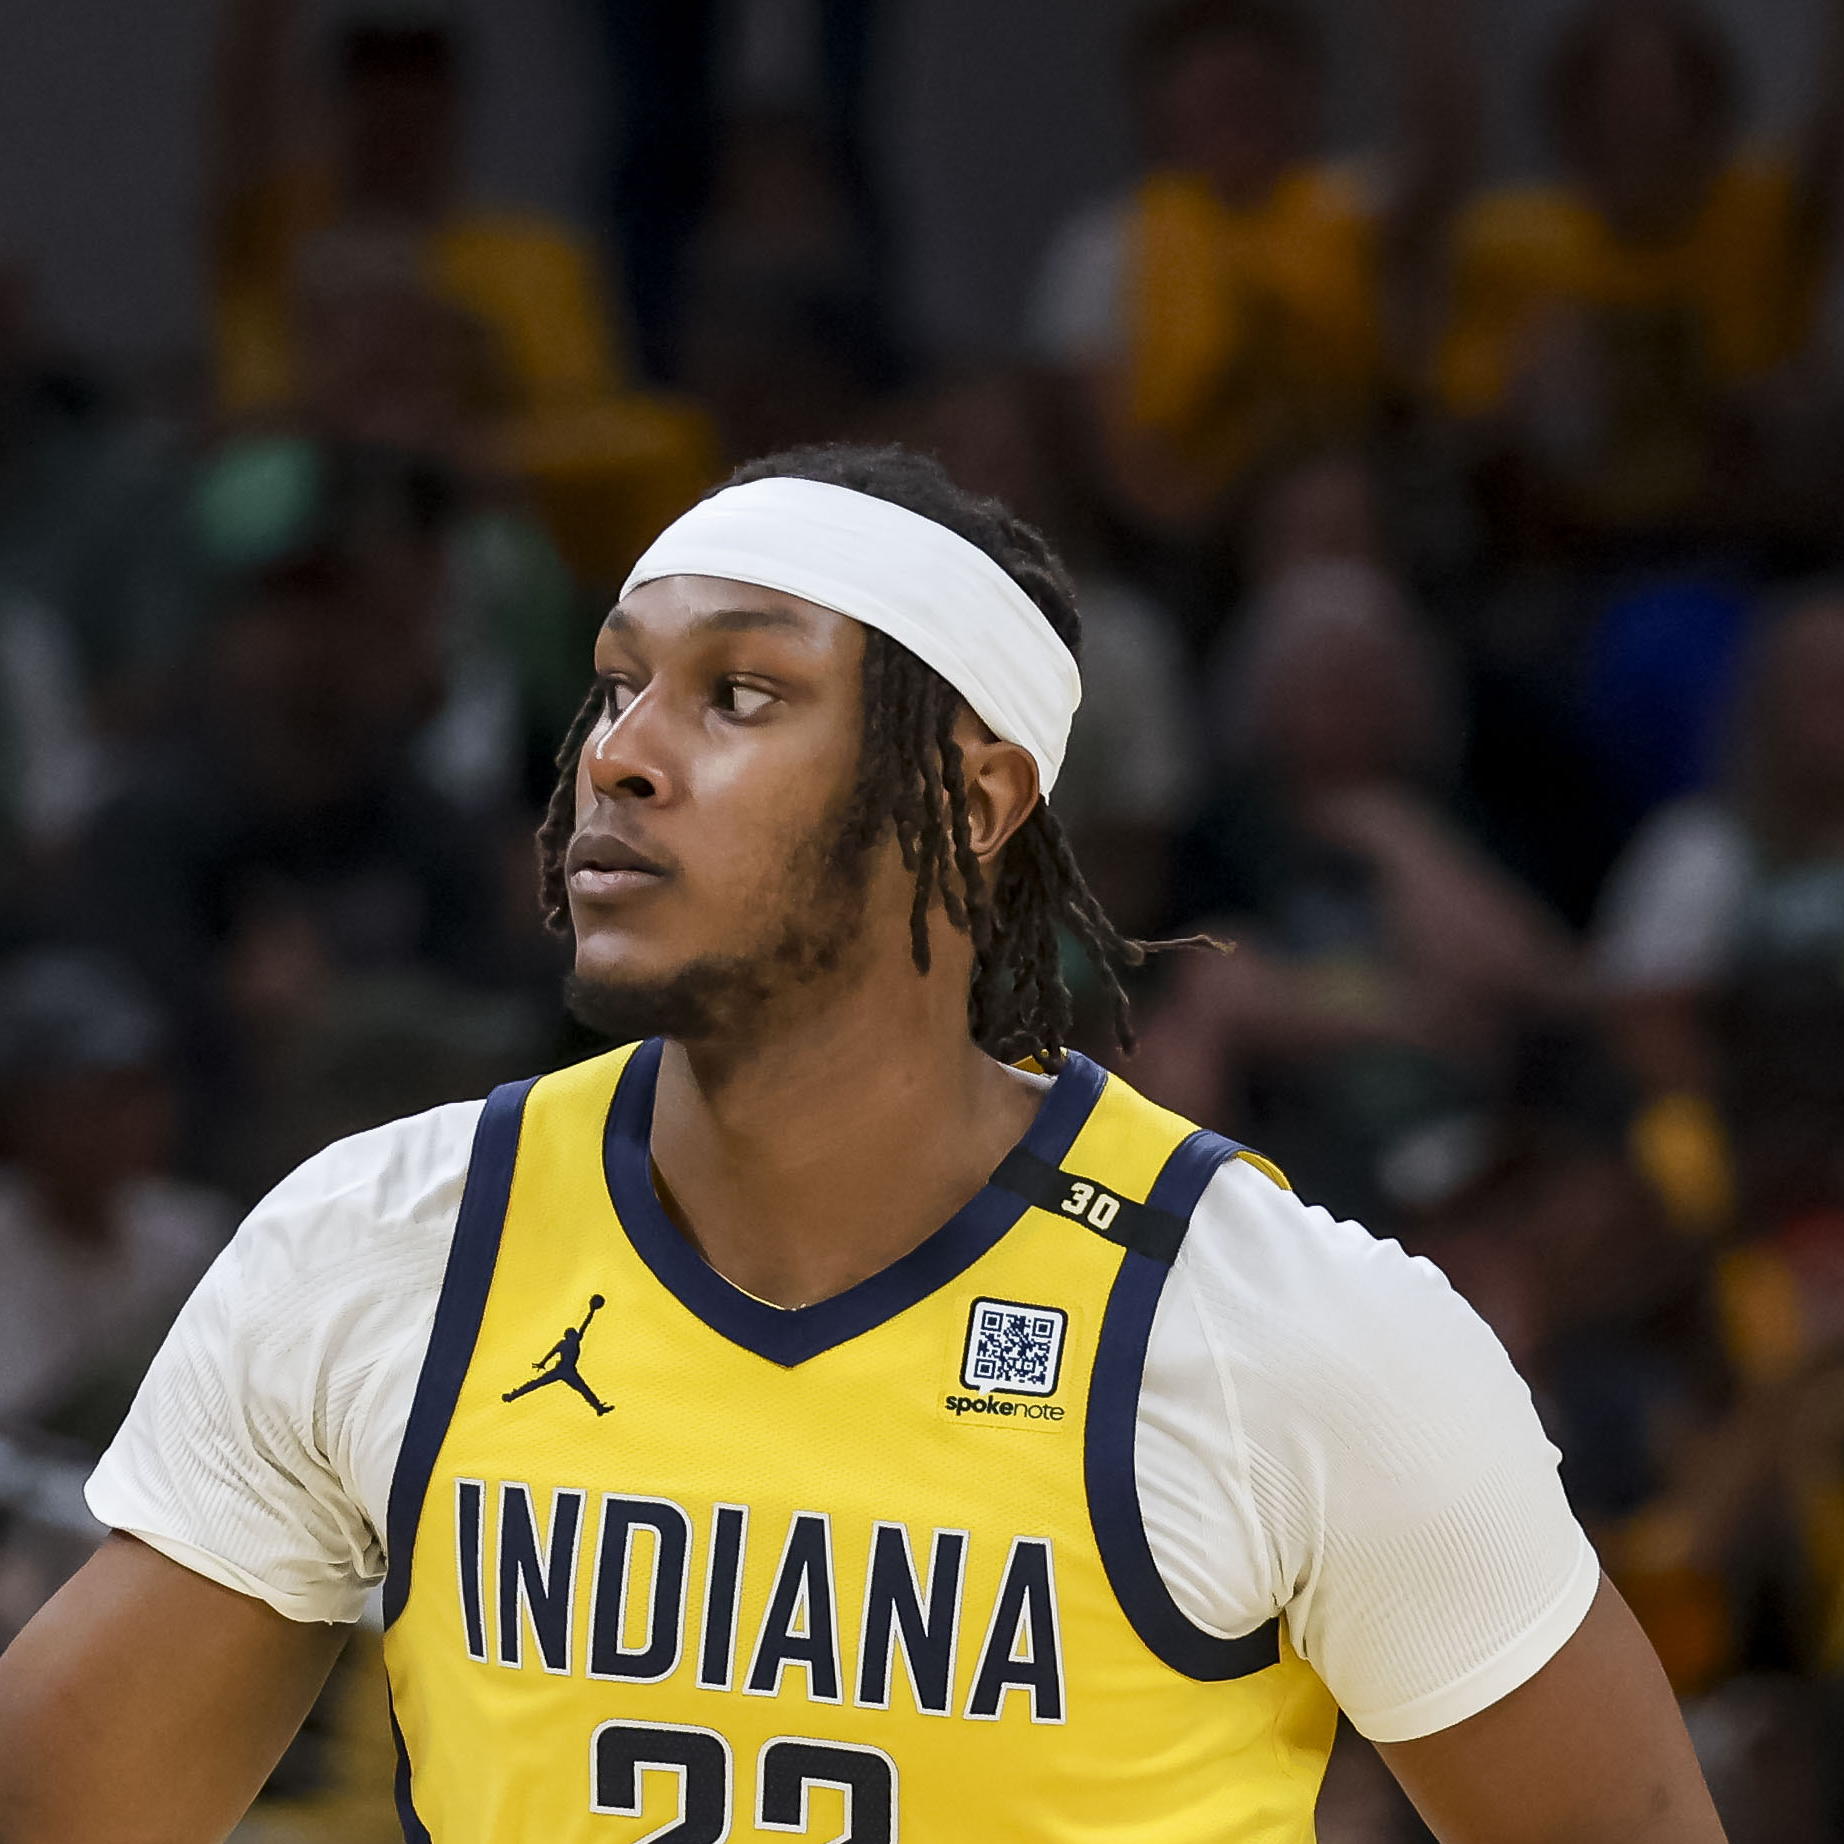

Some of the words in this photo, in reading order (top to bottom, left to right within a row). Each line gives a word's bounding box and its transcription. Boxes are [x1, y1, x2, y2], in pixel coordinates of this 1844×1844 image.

[1061, 1181, 1121, 1230] 30
[944, 1395, 1066, 1422] spokenote
[453, 1476, 1068, 1725] INDIANA
